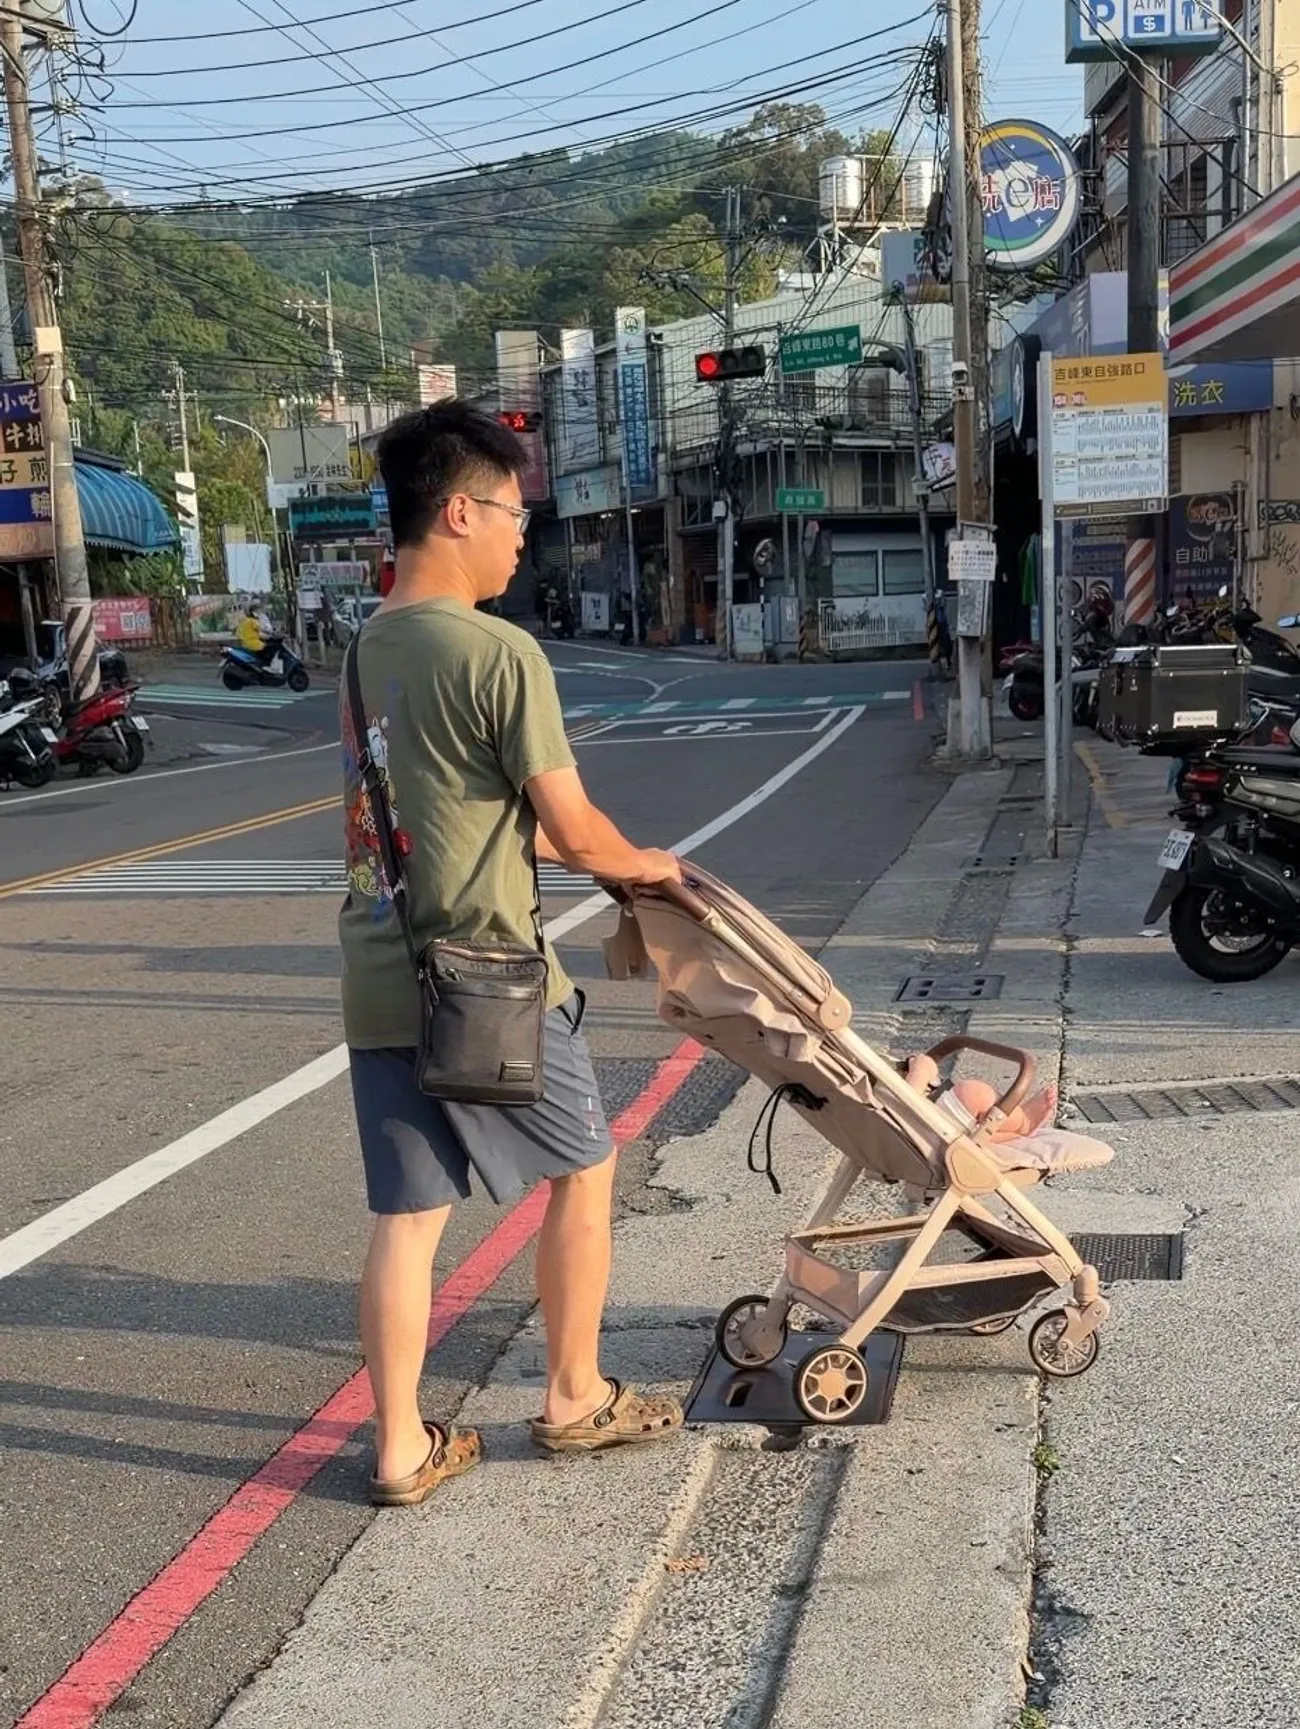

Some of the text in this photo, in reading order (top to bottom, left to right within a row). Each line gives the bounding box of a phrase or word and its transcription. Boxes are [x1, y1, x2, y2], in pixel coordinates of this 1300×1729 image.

[1088, 0, 1116, 35] P
[1054, 362, 1145, 381] 吉峰東自強路口
[1173, 380, 1225, 407] 洗衣
